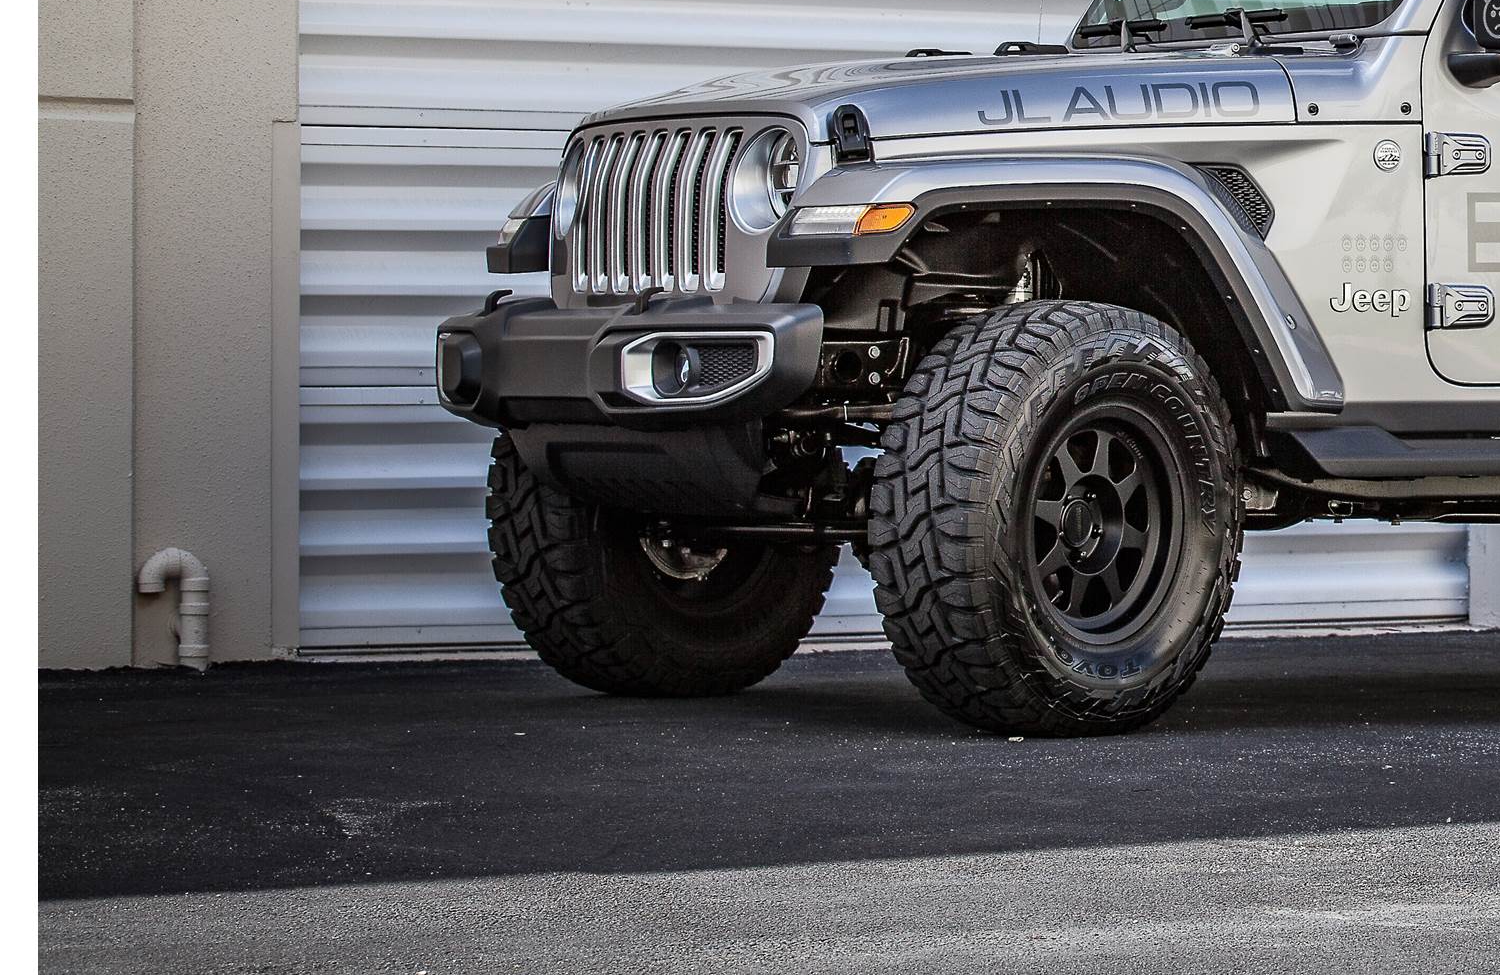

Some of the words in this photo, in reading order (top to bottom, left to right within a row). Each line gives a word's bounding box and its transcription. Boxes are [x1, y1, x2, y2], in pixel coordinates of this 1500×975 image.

[977, 89, 1052, 125] JL
[1061, 81, 1260, 122] AUDIO
[1330, 281, 1413, 318] Jeep
[1054, 647, 1143, 680] TOYO
